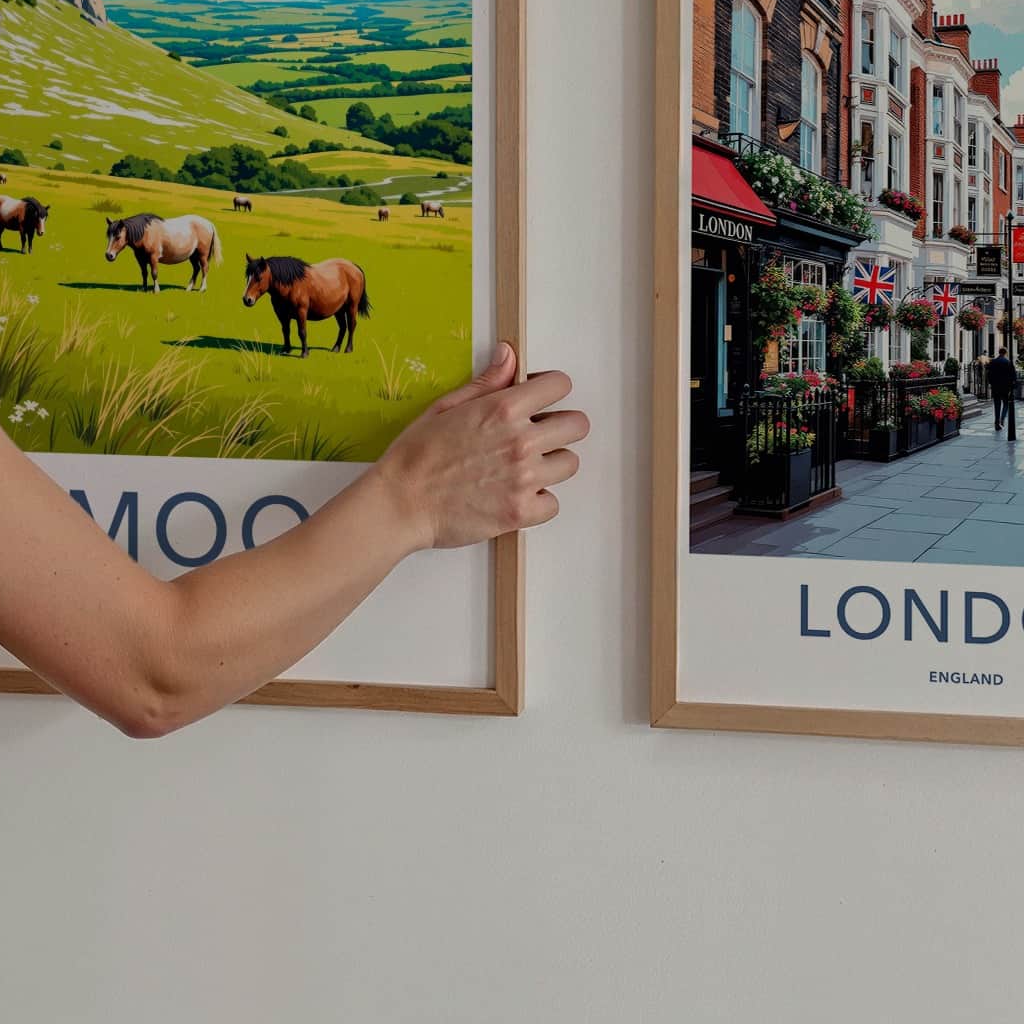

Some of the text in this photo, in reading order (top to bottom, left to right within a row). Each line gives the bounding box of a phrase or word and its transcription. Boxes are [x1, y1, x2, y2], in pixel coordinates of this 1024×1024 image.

[699, 213, 753, 242] LONDON
[800, 584, 1024, 645] LOND
[928, 670, 1004, 686] ENGLAND
